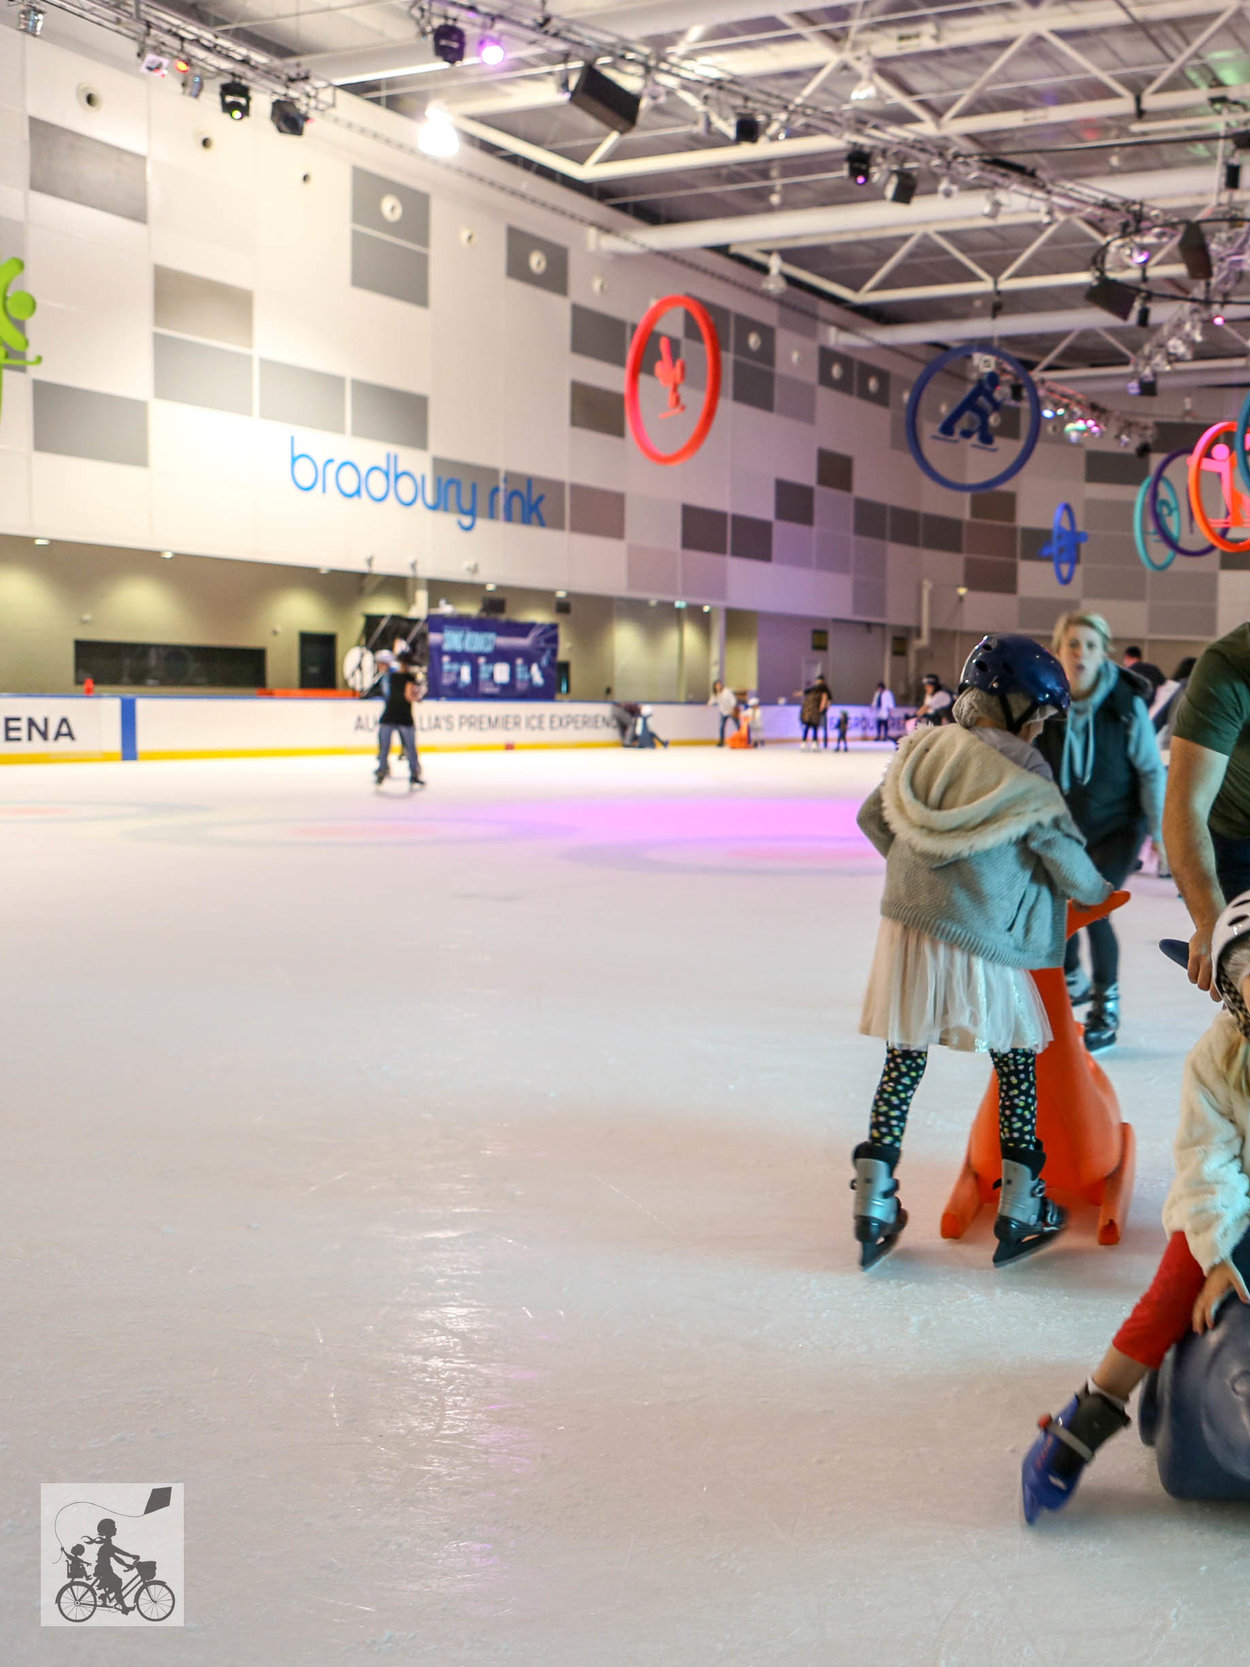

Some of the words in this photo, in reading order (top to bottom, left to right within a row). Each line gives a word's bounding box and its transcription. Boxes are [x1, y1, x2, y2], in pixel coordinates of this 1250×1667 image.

[290, 435, 477, 532] bradbury
[488, 476, 547, 528] rink
[4, 717, 75, 741] ENA
[458, 714, 522, 732] PREMIER
[525, 714, 545, 731] ICE
